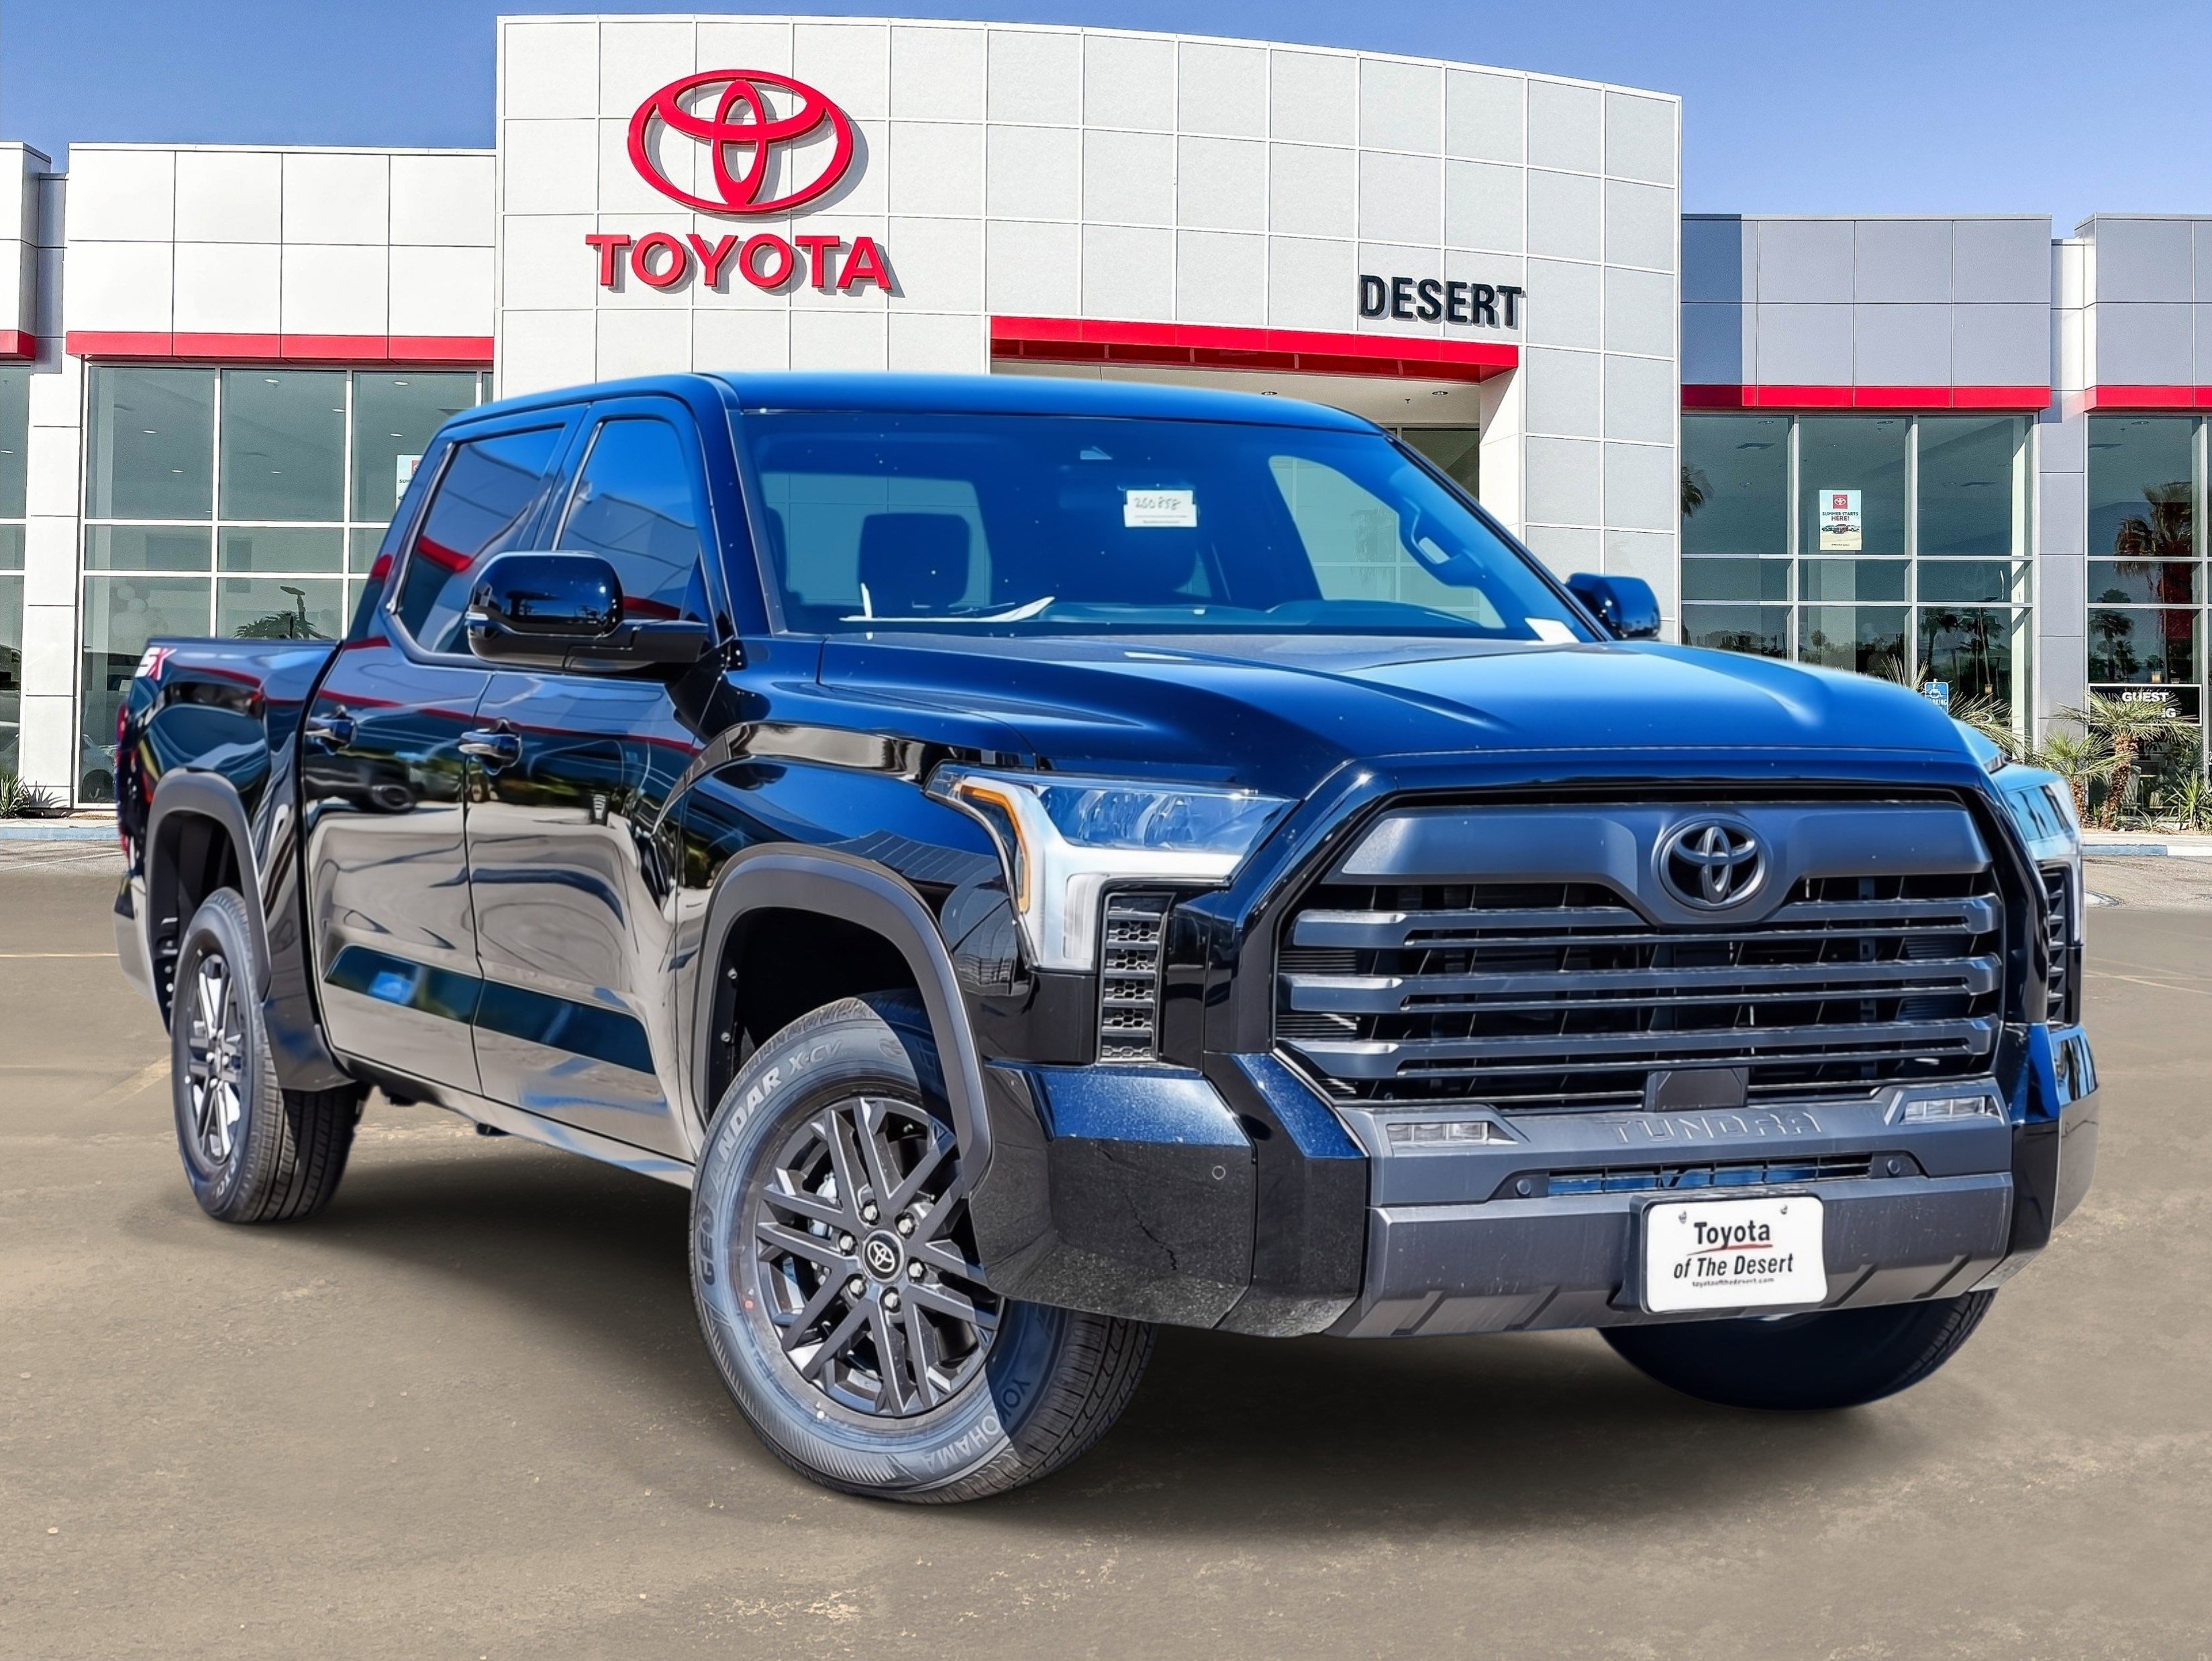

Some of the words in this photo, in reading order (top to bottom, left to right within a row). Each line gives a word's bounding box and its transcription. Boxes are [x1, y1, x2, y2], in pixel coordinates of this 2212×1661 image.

[585, 232, 893, 291] TOYOTA
[1359, 274, 1522, 326] DESERT
[2121, 691, 2169, 703] GUEST
[1595, 1112, 1821, 1144] TUNDRA
[1694, 1220, 1770, 1250] Toyota
[1674, 1258, 1692, 1279] of
[1697, 1256, 1727, 1276] The
[1733, 1253, 1794, 1276] Desert
[920, 1378, 1031, 1474] YOKOHAMA
